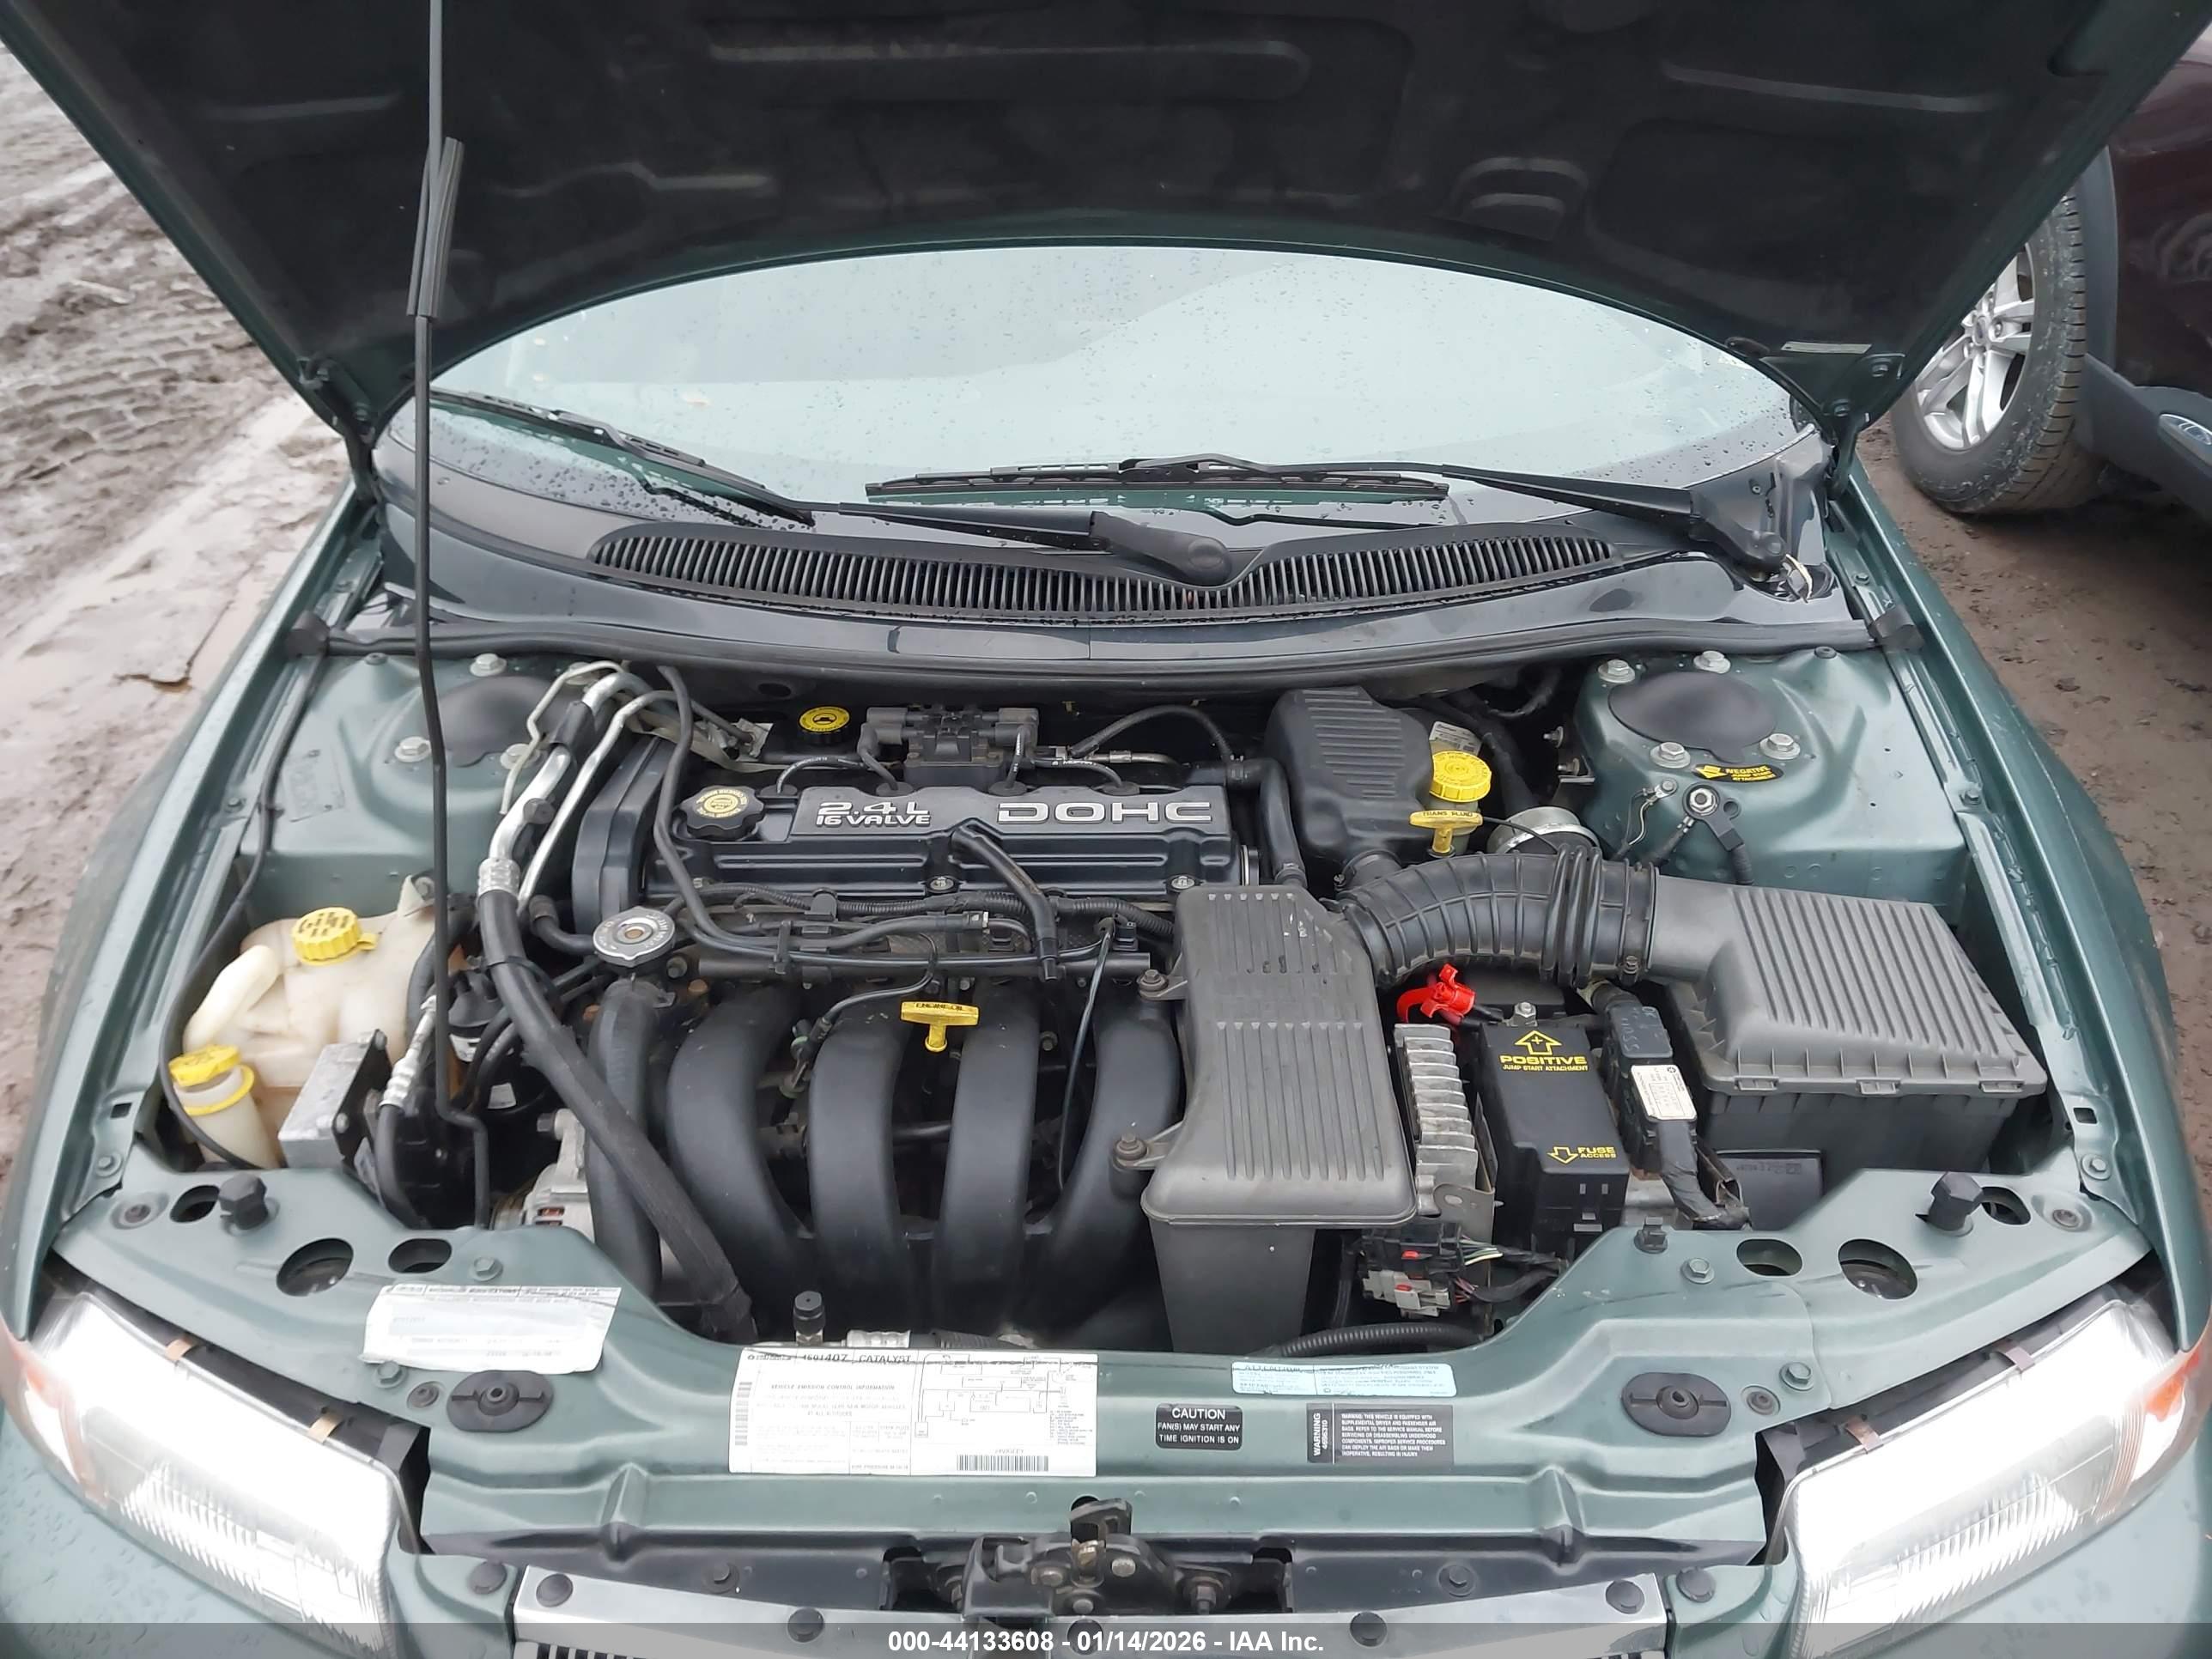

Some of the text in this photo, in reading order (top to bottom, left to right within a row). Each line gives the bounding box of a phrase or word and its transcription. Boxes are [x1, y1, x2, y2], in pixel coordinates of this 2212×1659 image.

[998, 801, 1212, 822] DOHC
[1499, 1055, 1587, 1065] POSITIVE
[859, 1354, 912, 1364] CATALYST
[1172, 1407, 1226, 1419] CAUTION
[1158, 1422, 1182, 1431] FAN(S)
[1183, 1423, 1198, 1431] MAY
[1159, 1434, 1177, 1443] TIME
[1180, 1434, 1215, 1443] IGNITION
[1227, 1436, 1239, 1444] ON
